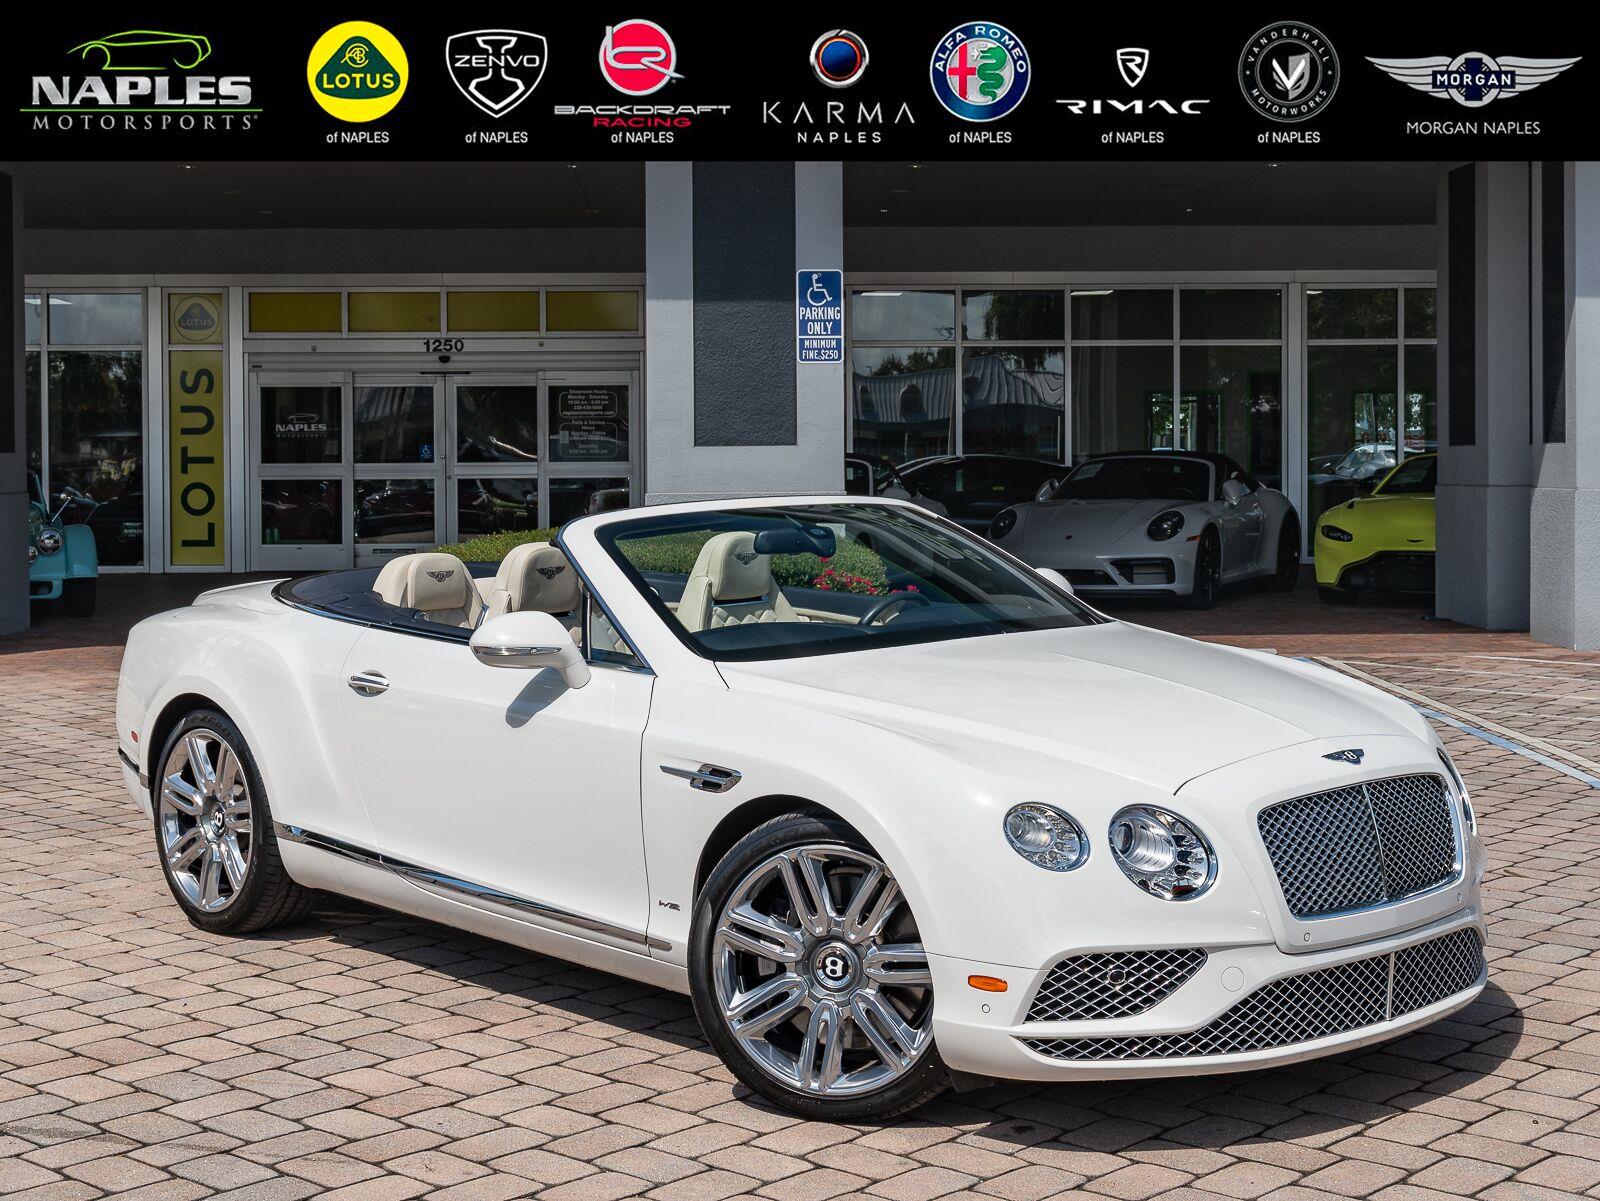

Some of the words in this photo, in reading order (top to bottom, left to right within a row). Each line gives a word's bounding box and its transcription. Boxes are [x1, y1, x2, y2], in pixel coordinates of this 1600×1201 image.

[800, 307, 841, 320] PARKING
[807, 321, 833, 335] ONLY
[423, 338, 465, 352] 1250
[804, 339, 836, 349] MINIMUM
[802, 350, 818, 360] FINE
[820, 349, 839, 360] $250
[275, 423, 327, 432] NAPLES
[180, 368, 216, 547] LOTUS
